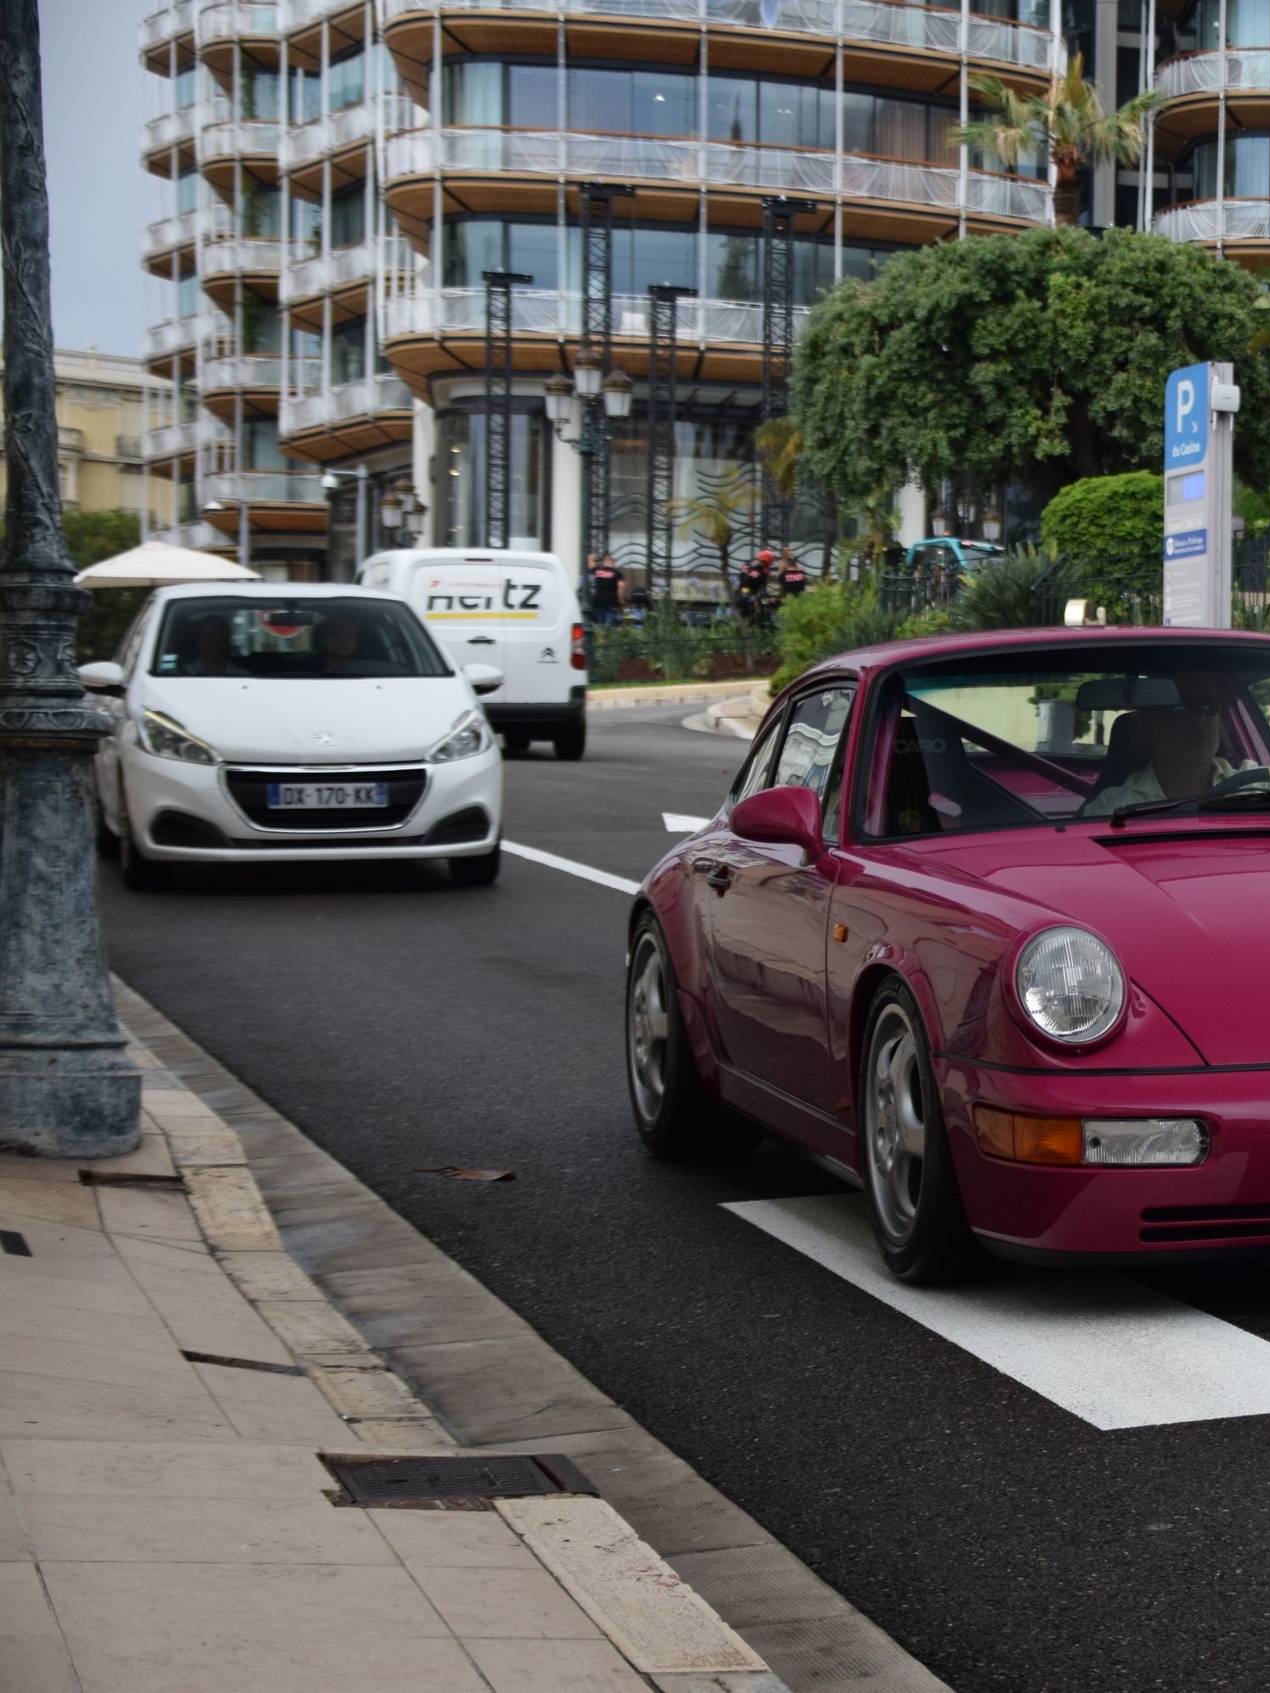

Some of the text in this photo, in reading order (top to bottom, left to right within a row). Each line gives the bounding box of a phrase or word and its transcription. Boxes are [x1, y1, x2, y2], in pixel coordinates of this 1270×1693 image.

[1177, 380, 1194, 434] P
[1171, 441, 1201, 458] du Casino
[894, 738, 947, 755] CARO
